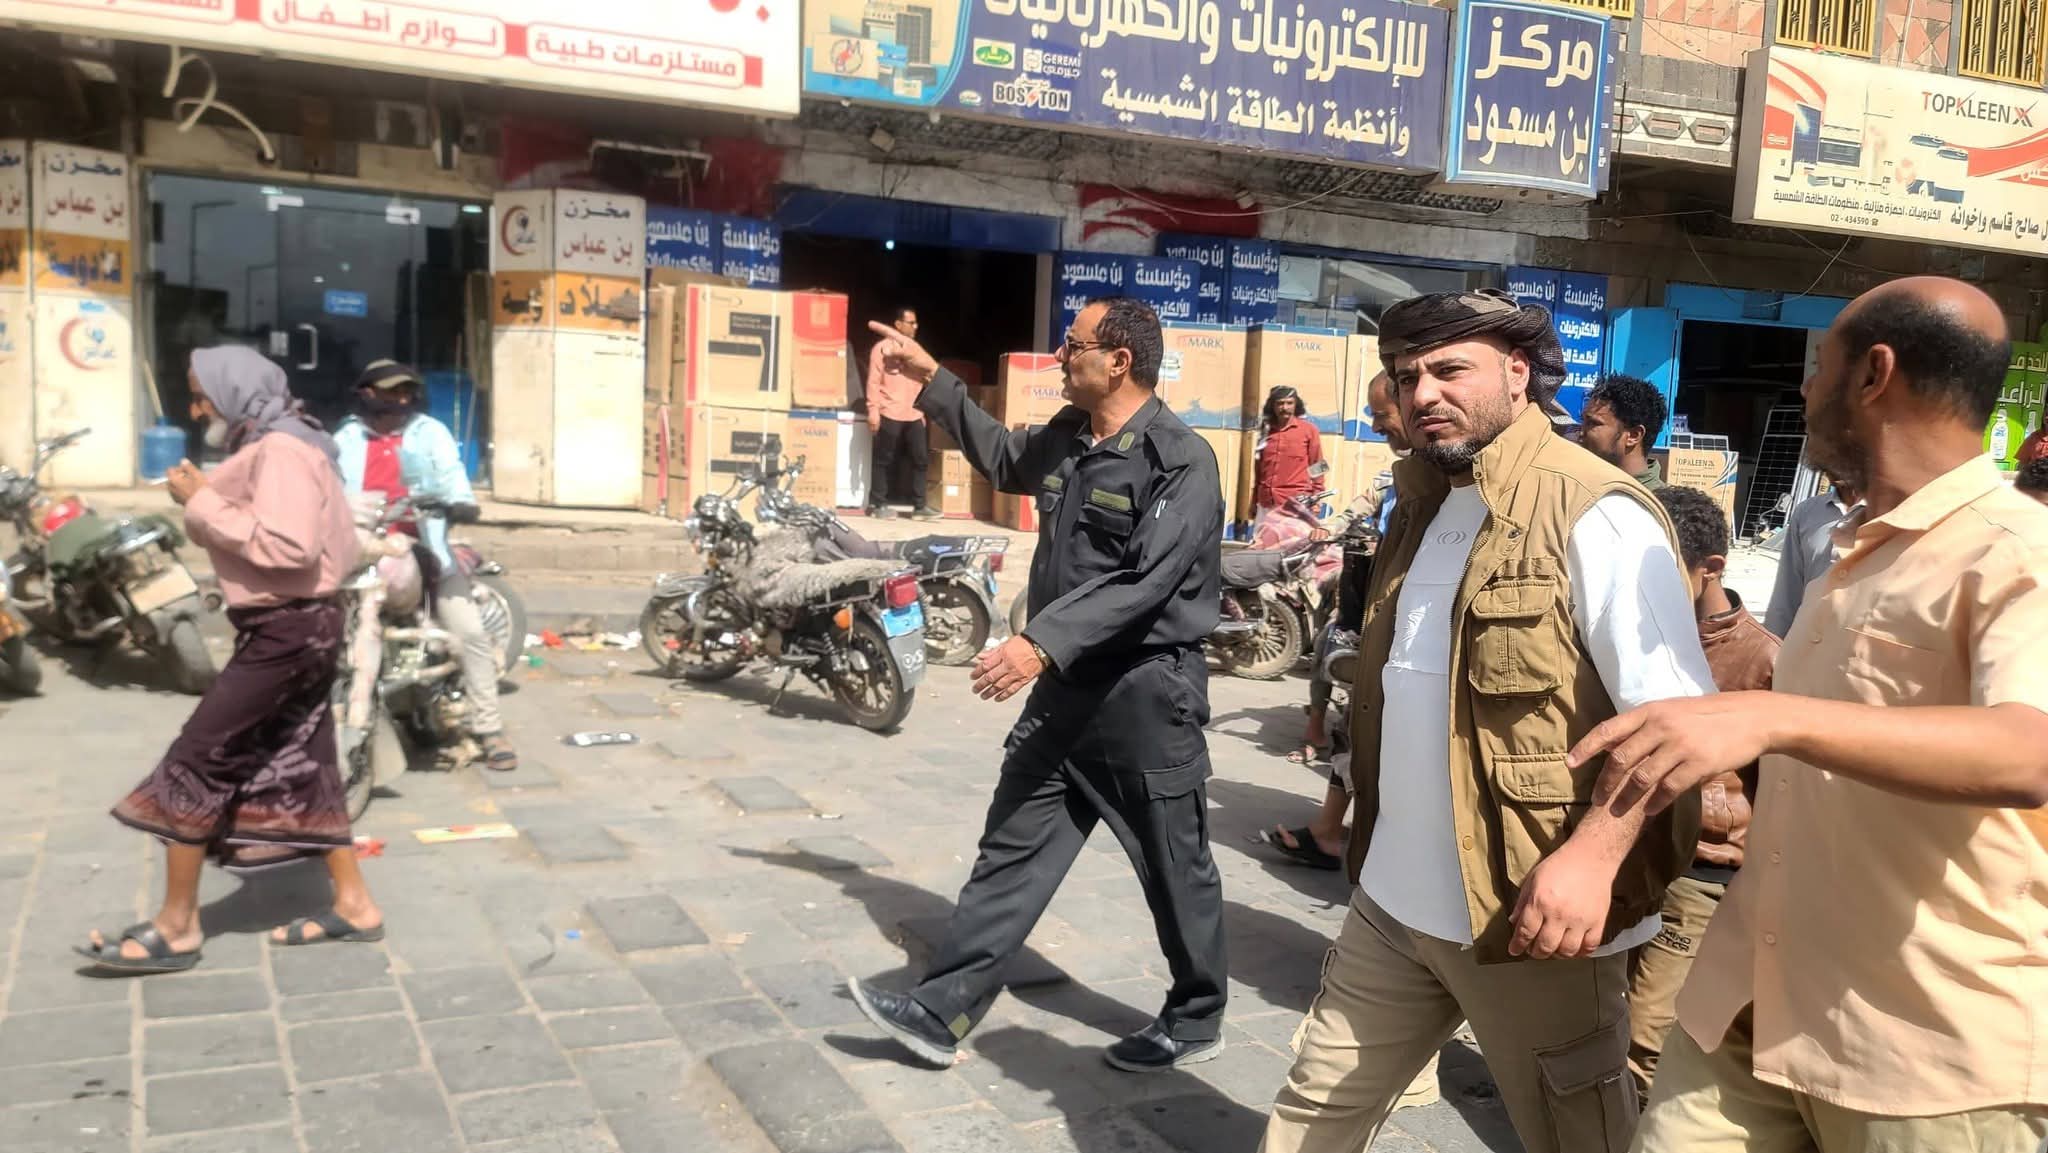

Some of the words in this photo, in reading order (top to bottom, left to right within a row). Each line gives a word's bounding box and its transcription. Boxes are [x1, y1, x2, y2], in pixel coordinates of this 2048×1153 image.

[535, 32, 605, 64] طبية
[613, 44, 736, 77] مستلزمات
[1475, 16, 1594, 87] مركز
[1101, 67, 1218, 122] الشمسية
[1227, 86, 1314, 136] الطاقة
[1323, 100, 1411, 157] وأنظمة
[1467, 94, 1556, 165] مسعود
[1560, 106, 1590, 176] بن
[49, 152, 123, 176] مخزن
[47, 186, 97, 220] عباس
[103, 193, 124, 227] بن
[564, 198, 631, 219] مخزن
[647, 220, 692, 246] مسعو
[1988, 211, 2013, 235] قاسم
[2014, 216, 2040, 240] صالح
[563, 233, 607, 261] عباس
[613, 236, 634, 267] بن
[722, 221, 780, 258] مؤسسة
[1061, 263, 1108, 286] مسعود
[1109, 261, 1123, 287] بن
[1232, 245, 1279, 275] مؤسسة
[1135, 263, 1191, 293] مؤسسة
[1564, 284, 1604, 312] مؤسسة
[1188, 337, 1222, 349] MARK
[1295, 341, 1322, 352] MARK
[1997, 381, 2048, 408] الزراعي
